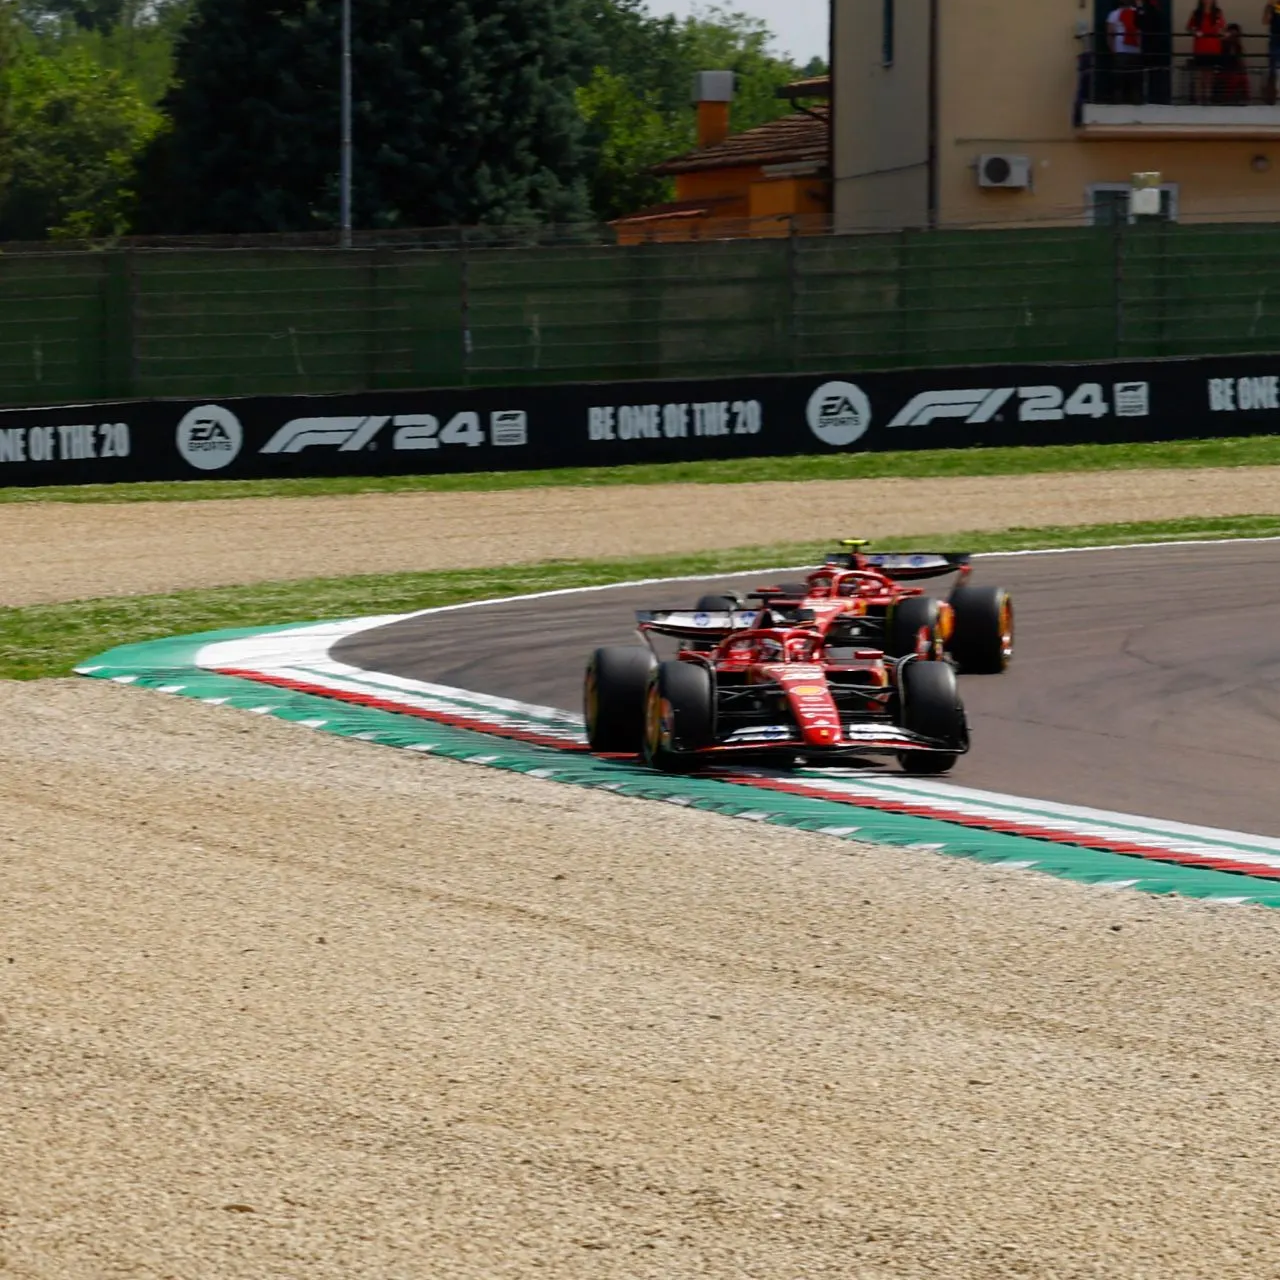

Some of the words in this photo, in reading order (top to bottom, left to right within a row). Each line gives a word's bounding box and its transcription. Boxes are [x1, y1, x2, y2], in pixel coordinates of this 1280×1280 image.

[819, 396, 859, 416] EA
[887, 387, 1016, 427] F1
[1017, 382, 1109, 421] 24
[1208, 377, 1236, 411] BE
[1237, 375, 1280, 410] ONE
[188, 419, 230, 441] EA
[259, 415, 392, 453] F1
[393, 411, 485, 449] 24
[588, 406, 616, 441] BE
[617, 404, 661, 440] ONE
[662, 403, 690, 438] OF
[692, 401, 730, 436] THE
[731, 399, 761, 434] 20
[818, 416, 860, 428] SPORTS
[0, 428, 26, 462] NE
[29, 426, 54, 461] OF
[57, 424, 97, 460] THE
[99, 422, 130, 458] 20
[188, 442, 232, 452] SPORTS
